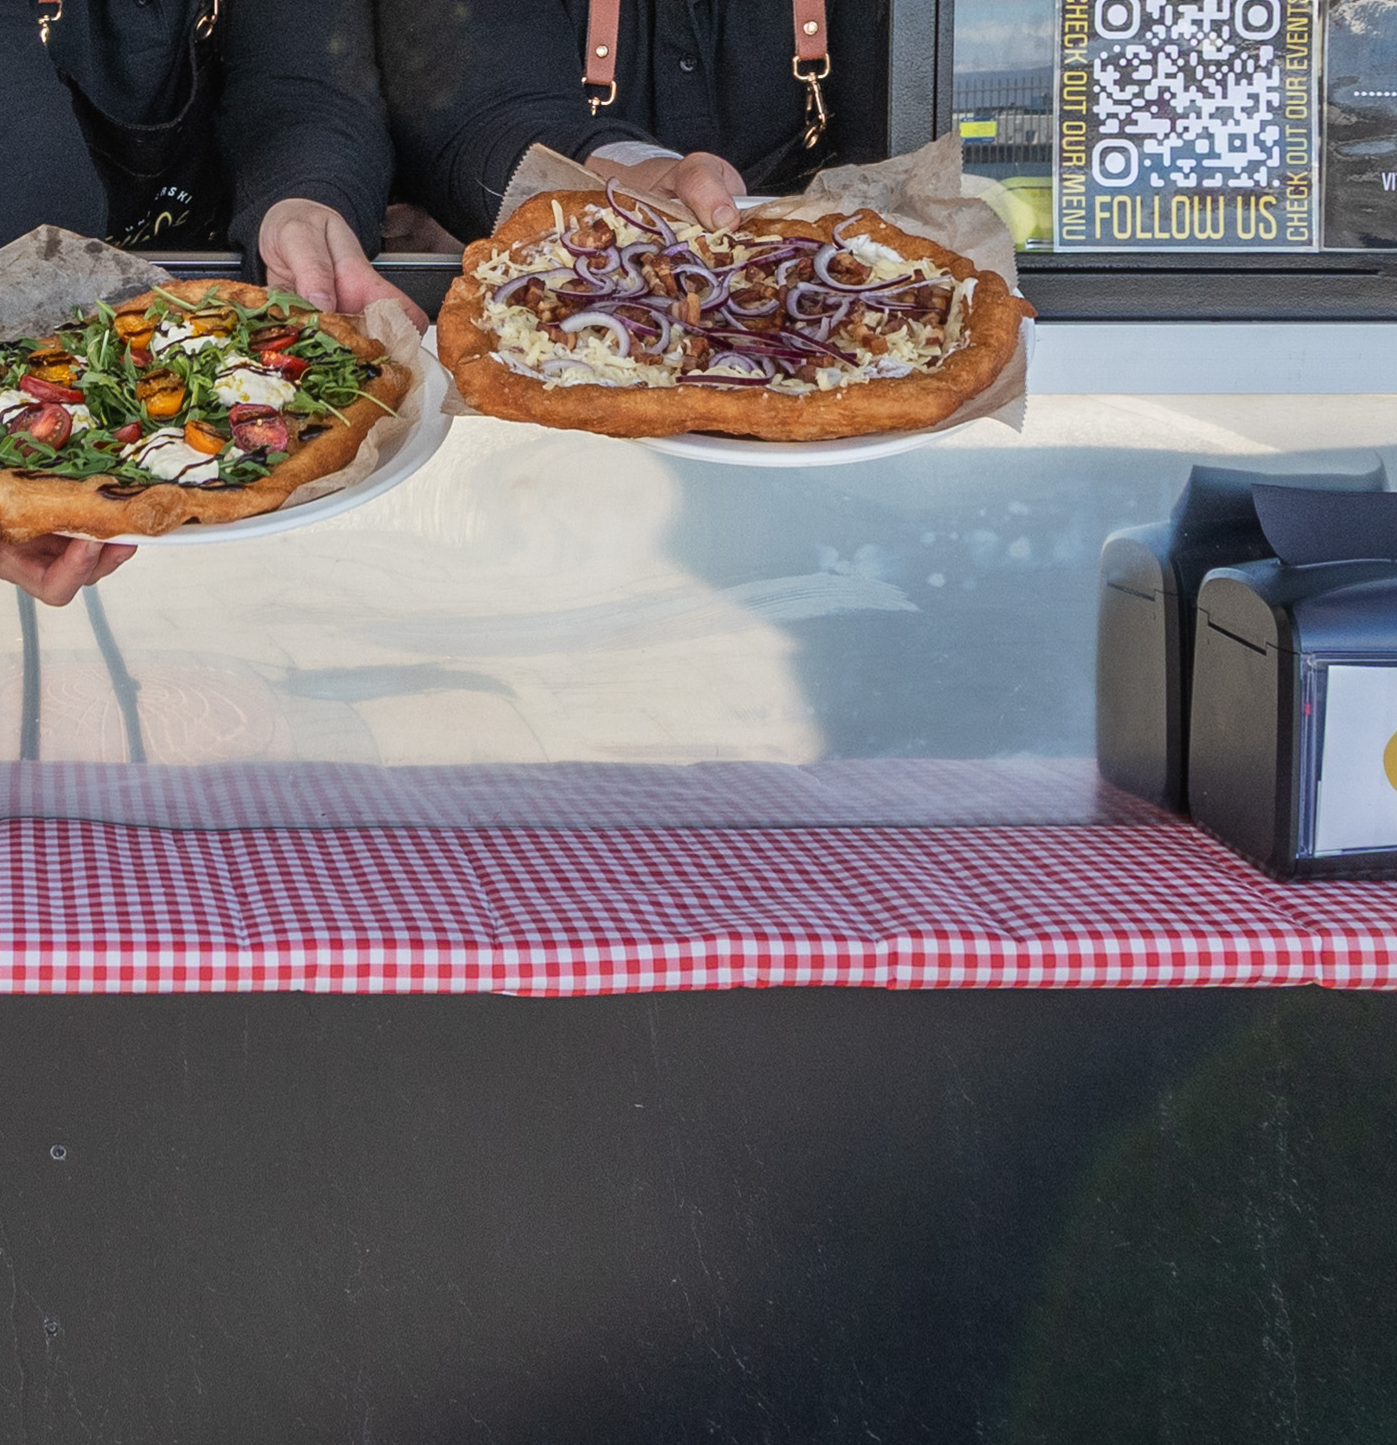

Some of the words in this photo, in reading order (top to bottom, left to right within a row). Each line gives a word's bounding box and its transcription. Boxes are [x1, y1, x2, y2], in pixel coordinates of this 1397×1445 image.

[1062, 70, 1088, 115] OUT
[1285, 81, 1308, 120] OUR
[1061, 121, 1086, 167] OUR
[1285, 126, 1308, 165] OUT
[1061, 173, 1086, 241] MENU
[1094, 195, 1225, 240] FOLLOW
[1236, 195, 1278, 240] US
[1286, 170, 1309, 241] CHECK
